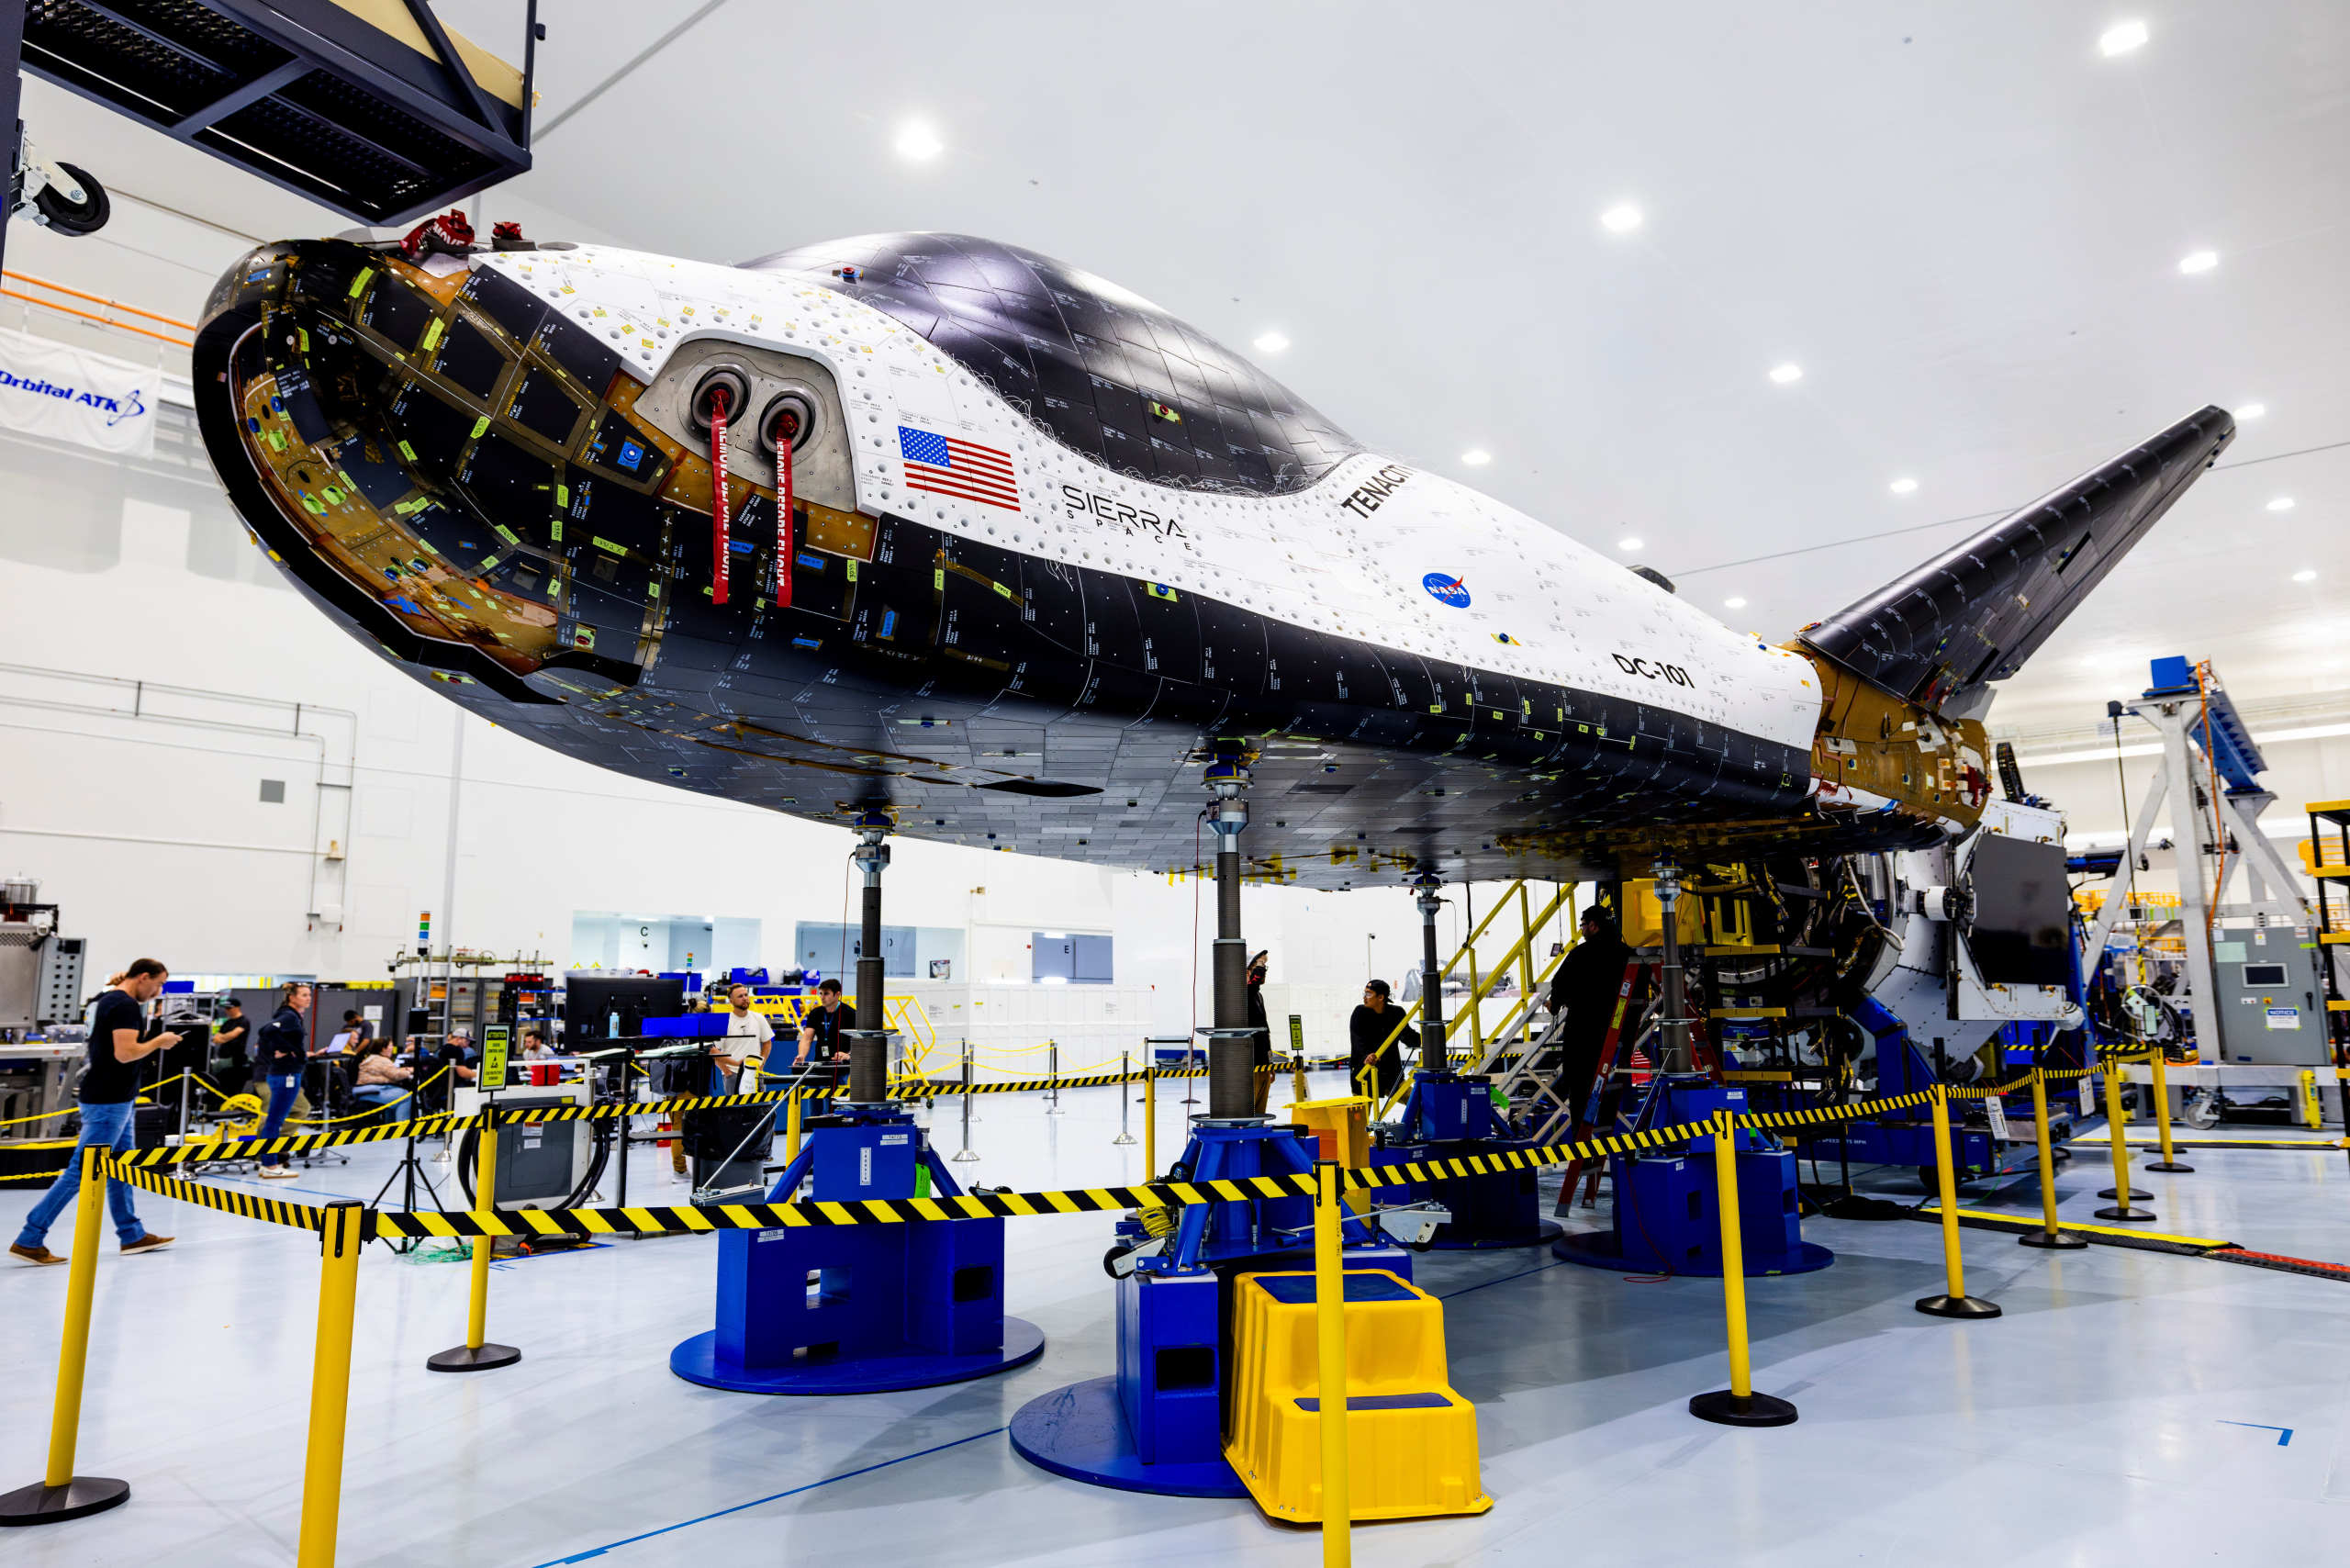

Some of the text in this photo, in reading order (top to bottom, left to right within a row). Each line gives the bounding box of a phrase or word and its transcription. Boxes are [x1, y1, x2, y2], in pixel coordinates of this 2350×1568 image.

[0, 371, 121, 413] Orbital ATK
[1063, 485, 1187, 538] SIERRA
[1341, 464, 1418, 519] TENACIT
[1067, 510, 1192, 551] SPACE
[1611, 653, 1695, 689] DC-101
[640, 925, 648, 936] C
[1064, 945, 1069, 954] E
